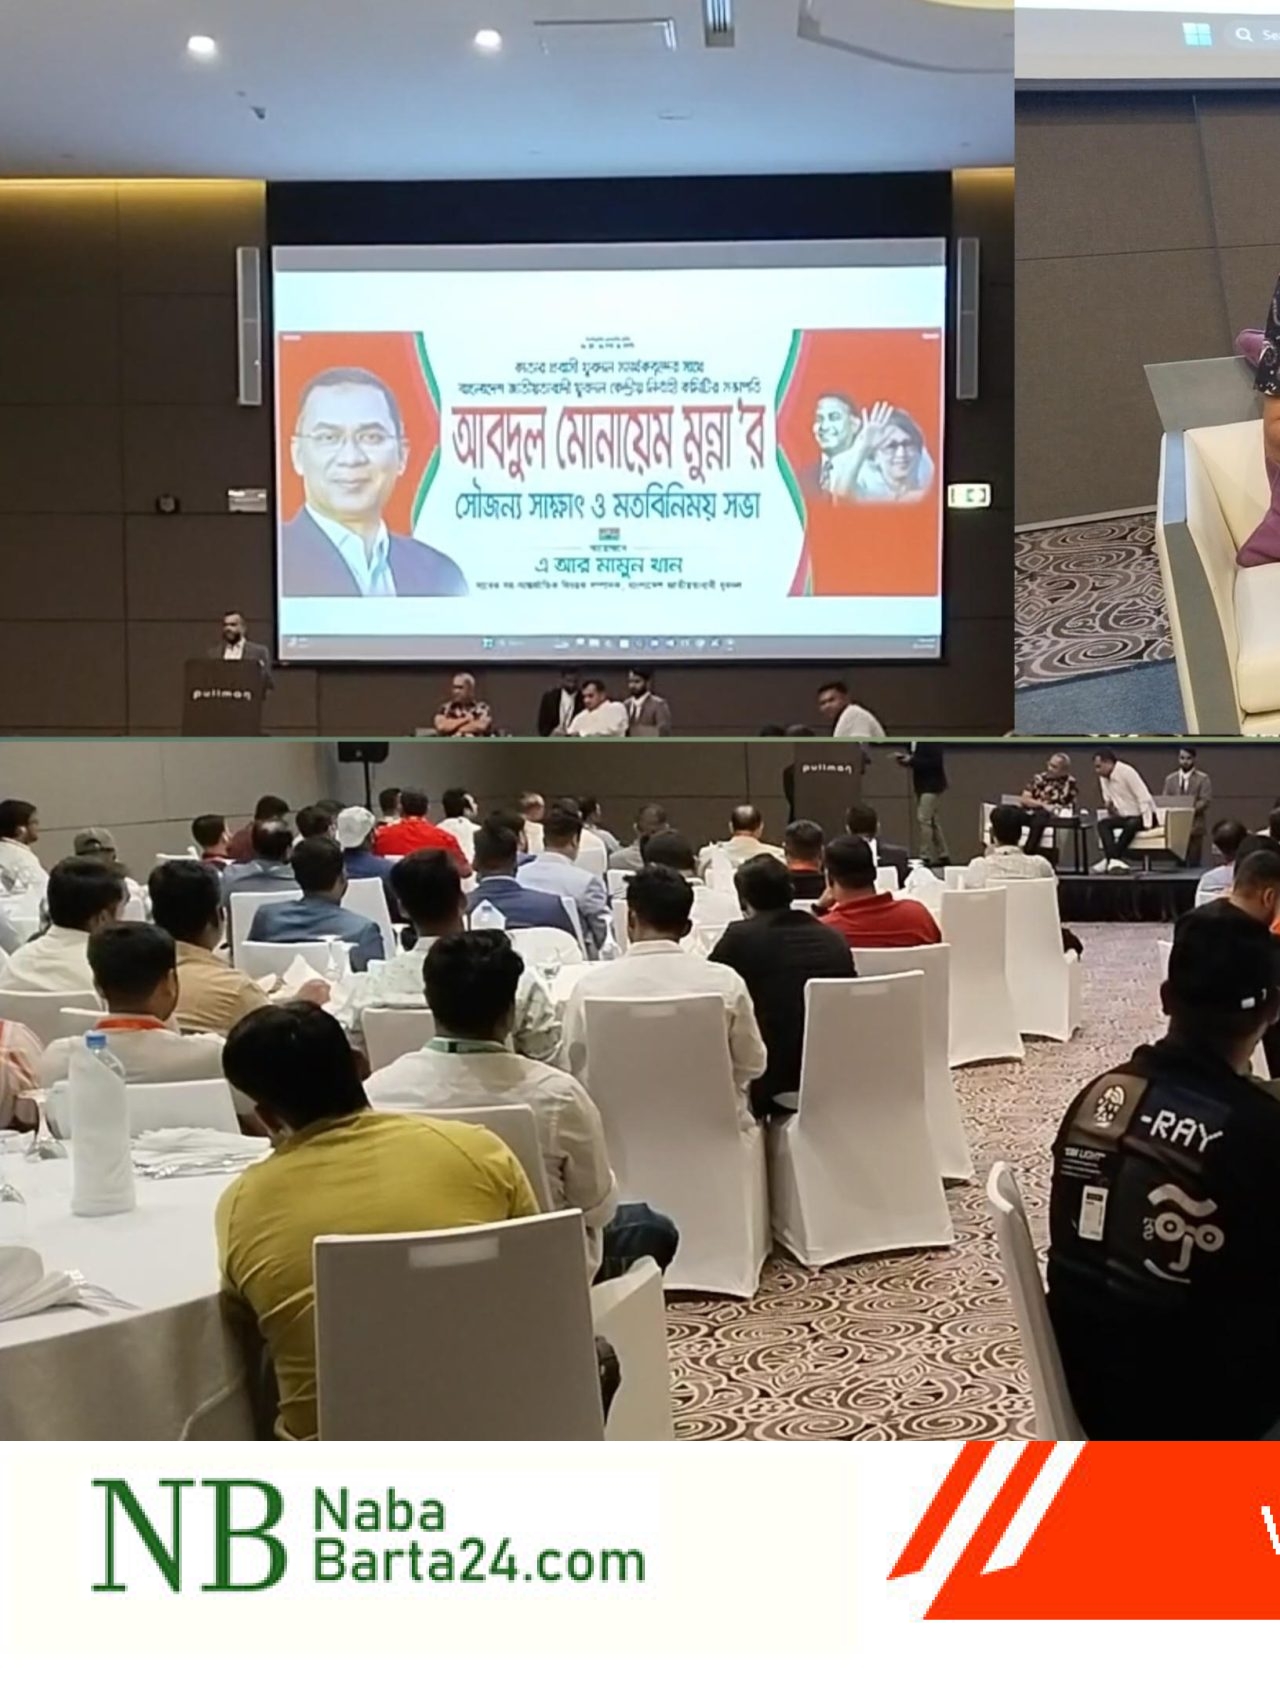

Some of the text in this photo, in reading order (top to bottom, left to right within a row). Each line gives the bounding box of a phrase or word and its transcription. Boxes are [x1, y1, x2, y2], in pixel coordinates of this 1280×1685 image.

[451, 406, 548, 483] আবদুল
[556, 406, 674, 476] মোনায়েম
[455, 477, 762, 521] সৌজন্য সাক্ষাৎ ও মতবিনিময় সভা
[535, 557, 683, 579] এ আর মামুন খান
[193, 687, 252, 701] pullman
[802, 763, 852, 775] pullman
[1140, 1109, 1224, 1152] -RAY
